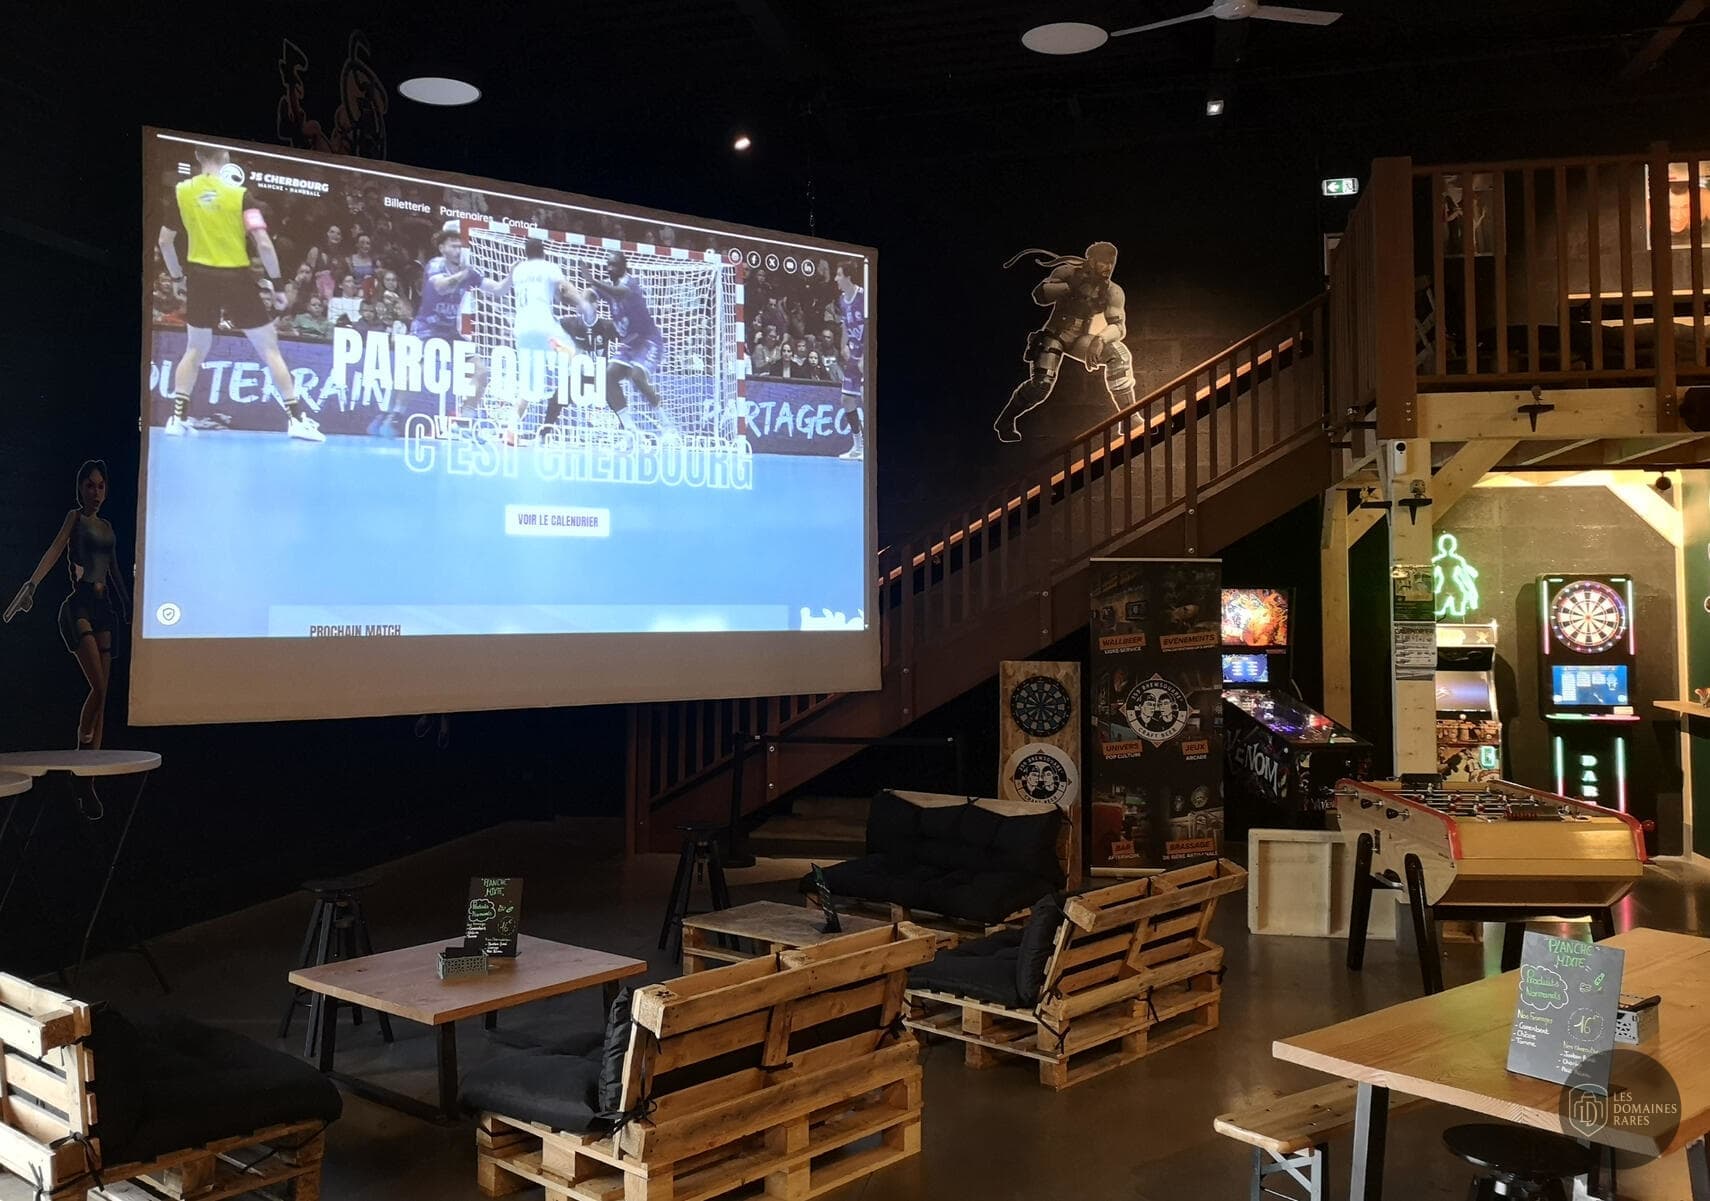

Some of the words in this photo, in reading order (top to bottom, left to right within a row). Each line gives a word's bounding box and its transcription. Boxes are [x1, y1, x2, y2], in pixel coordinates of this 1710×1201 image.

[250, 171, 263, 181] JS
[264, 174, 329, 192] CHERBOURG
[384, 197, 431, 213] Billetterie
[440, 206, 493, 222] Partenaires
[502, 217, 538, 230] Contact
[333, 327, 476, 396] PARCE
[534, 422, 753, 490] CHERBOURG
[518, 514, 537, 525] VOIR
[540, 515, 549, 526] LE
[551, 515, 599, 527] CALENDRIER
[309, 624, 362, 637] PROCHAIN
[365, 624, 401, 636] MATCH
[1102, 636, 1143, 647] WALLBEER
[1138, 727, 1158, 738] CRAFT
[1184, 744, 1206, 752] JEUX
[1555, 954, 1586, 968] MIXTE
